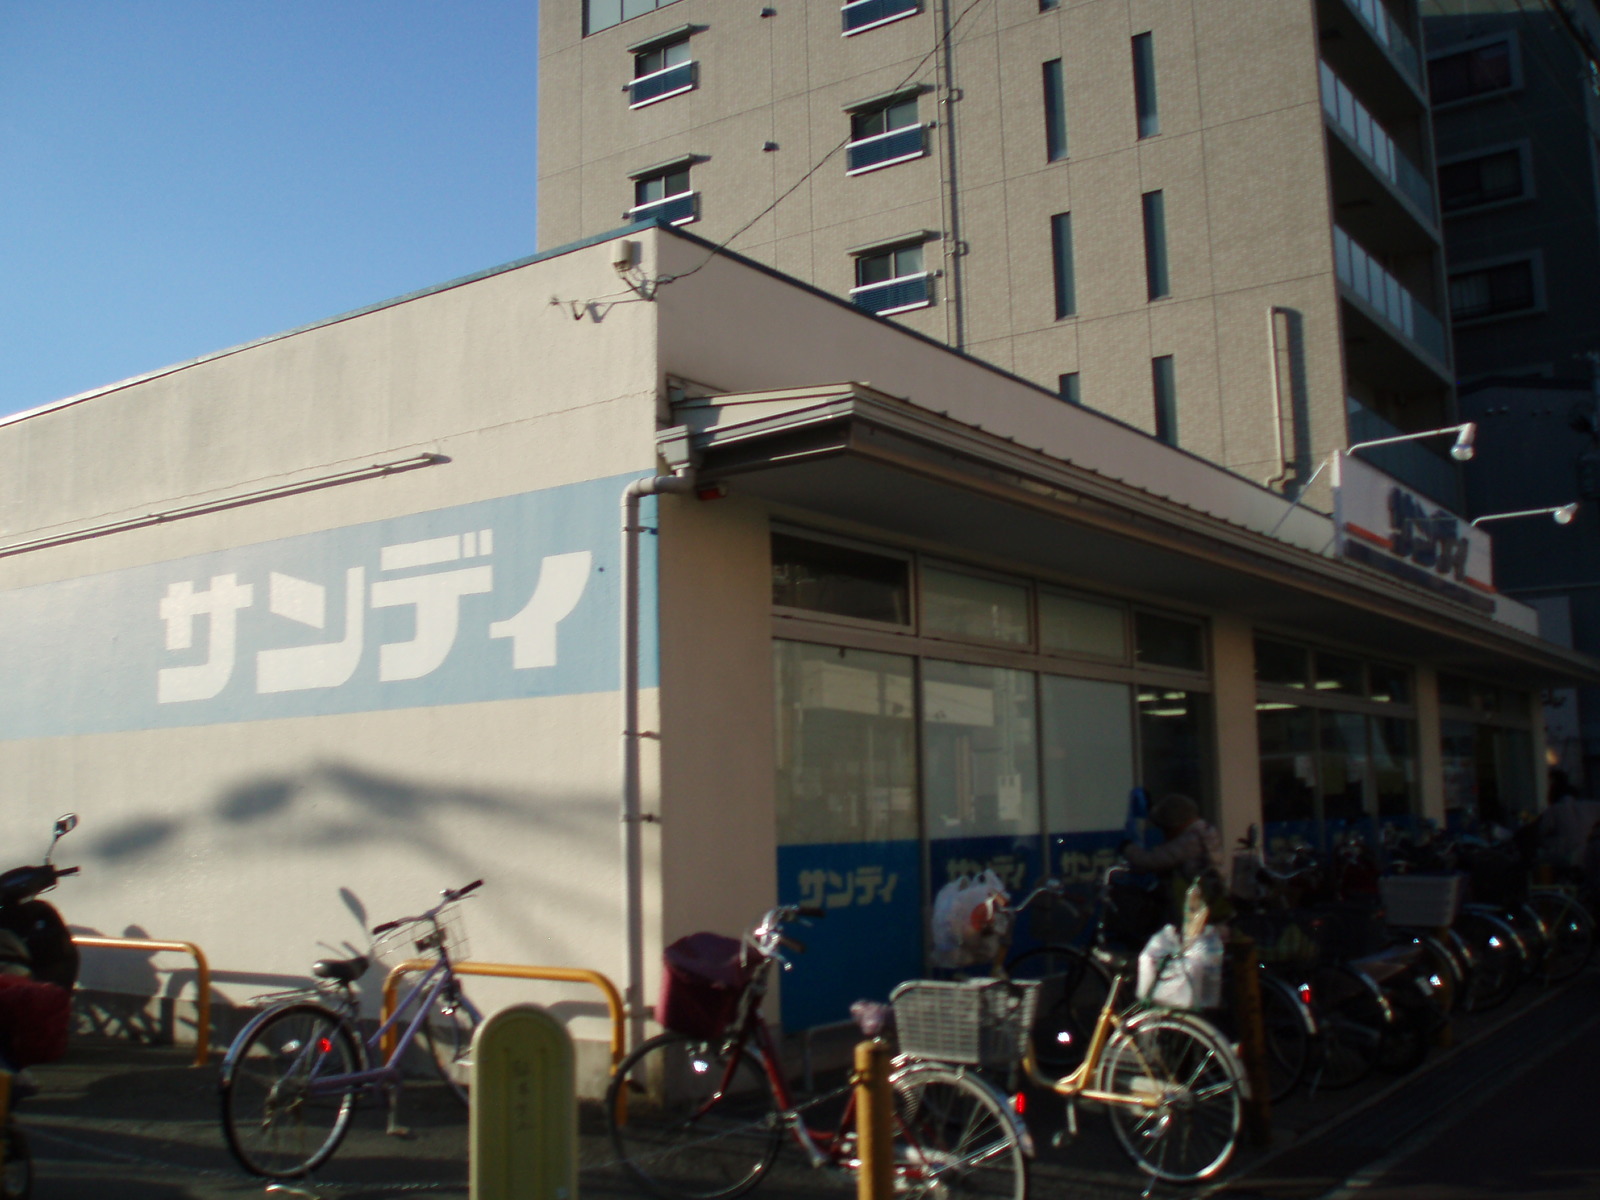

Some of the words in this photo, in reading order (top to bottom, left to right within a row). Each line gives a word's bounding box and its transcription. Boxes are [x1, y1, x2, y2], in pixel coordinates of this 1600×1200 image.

[158, 528, 592, 704] サンディ
[799, 865, 897, 908] サンディ
